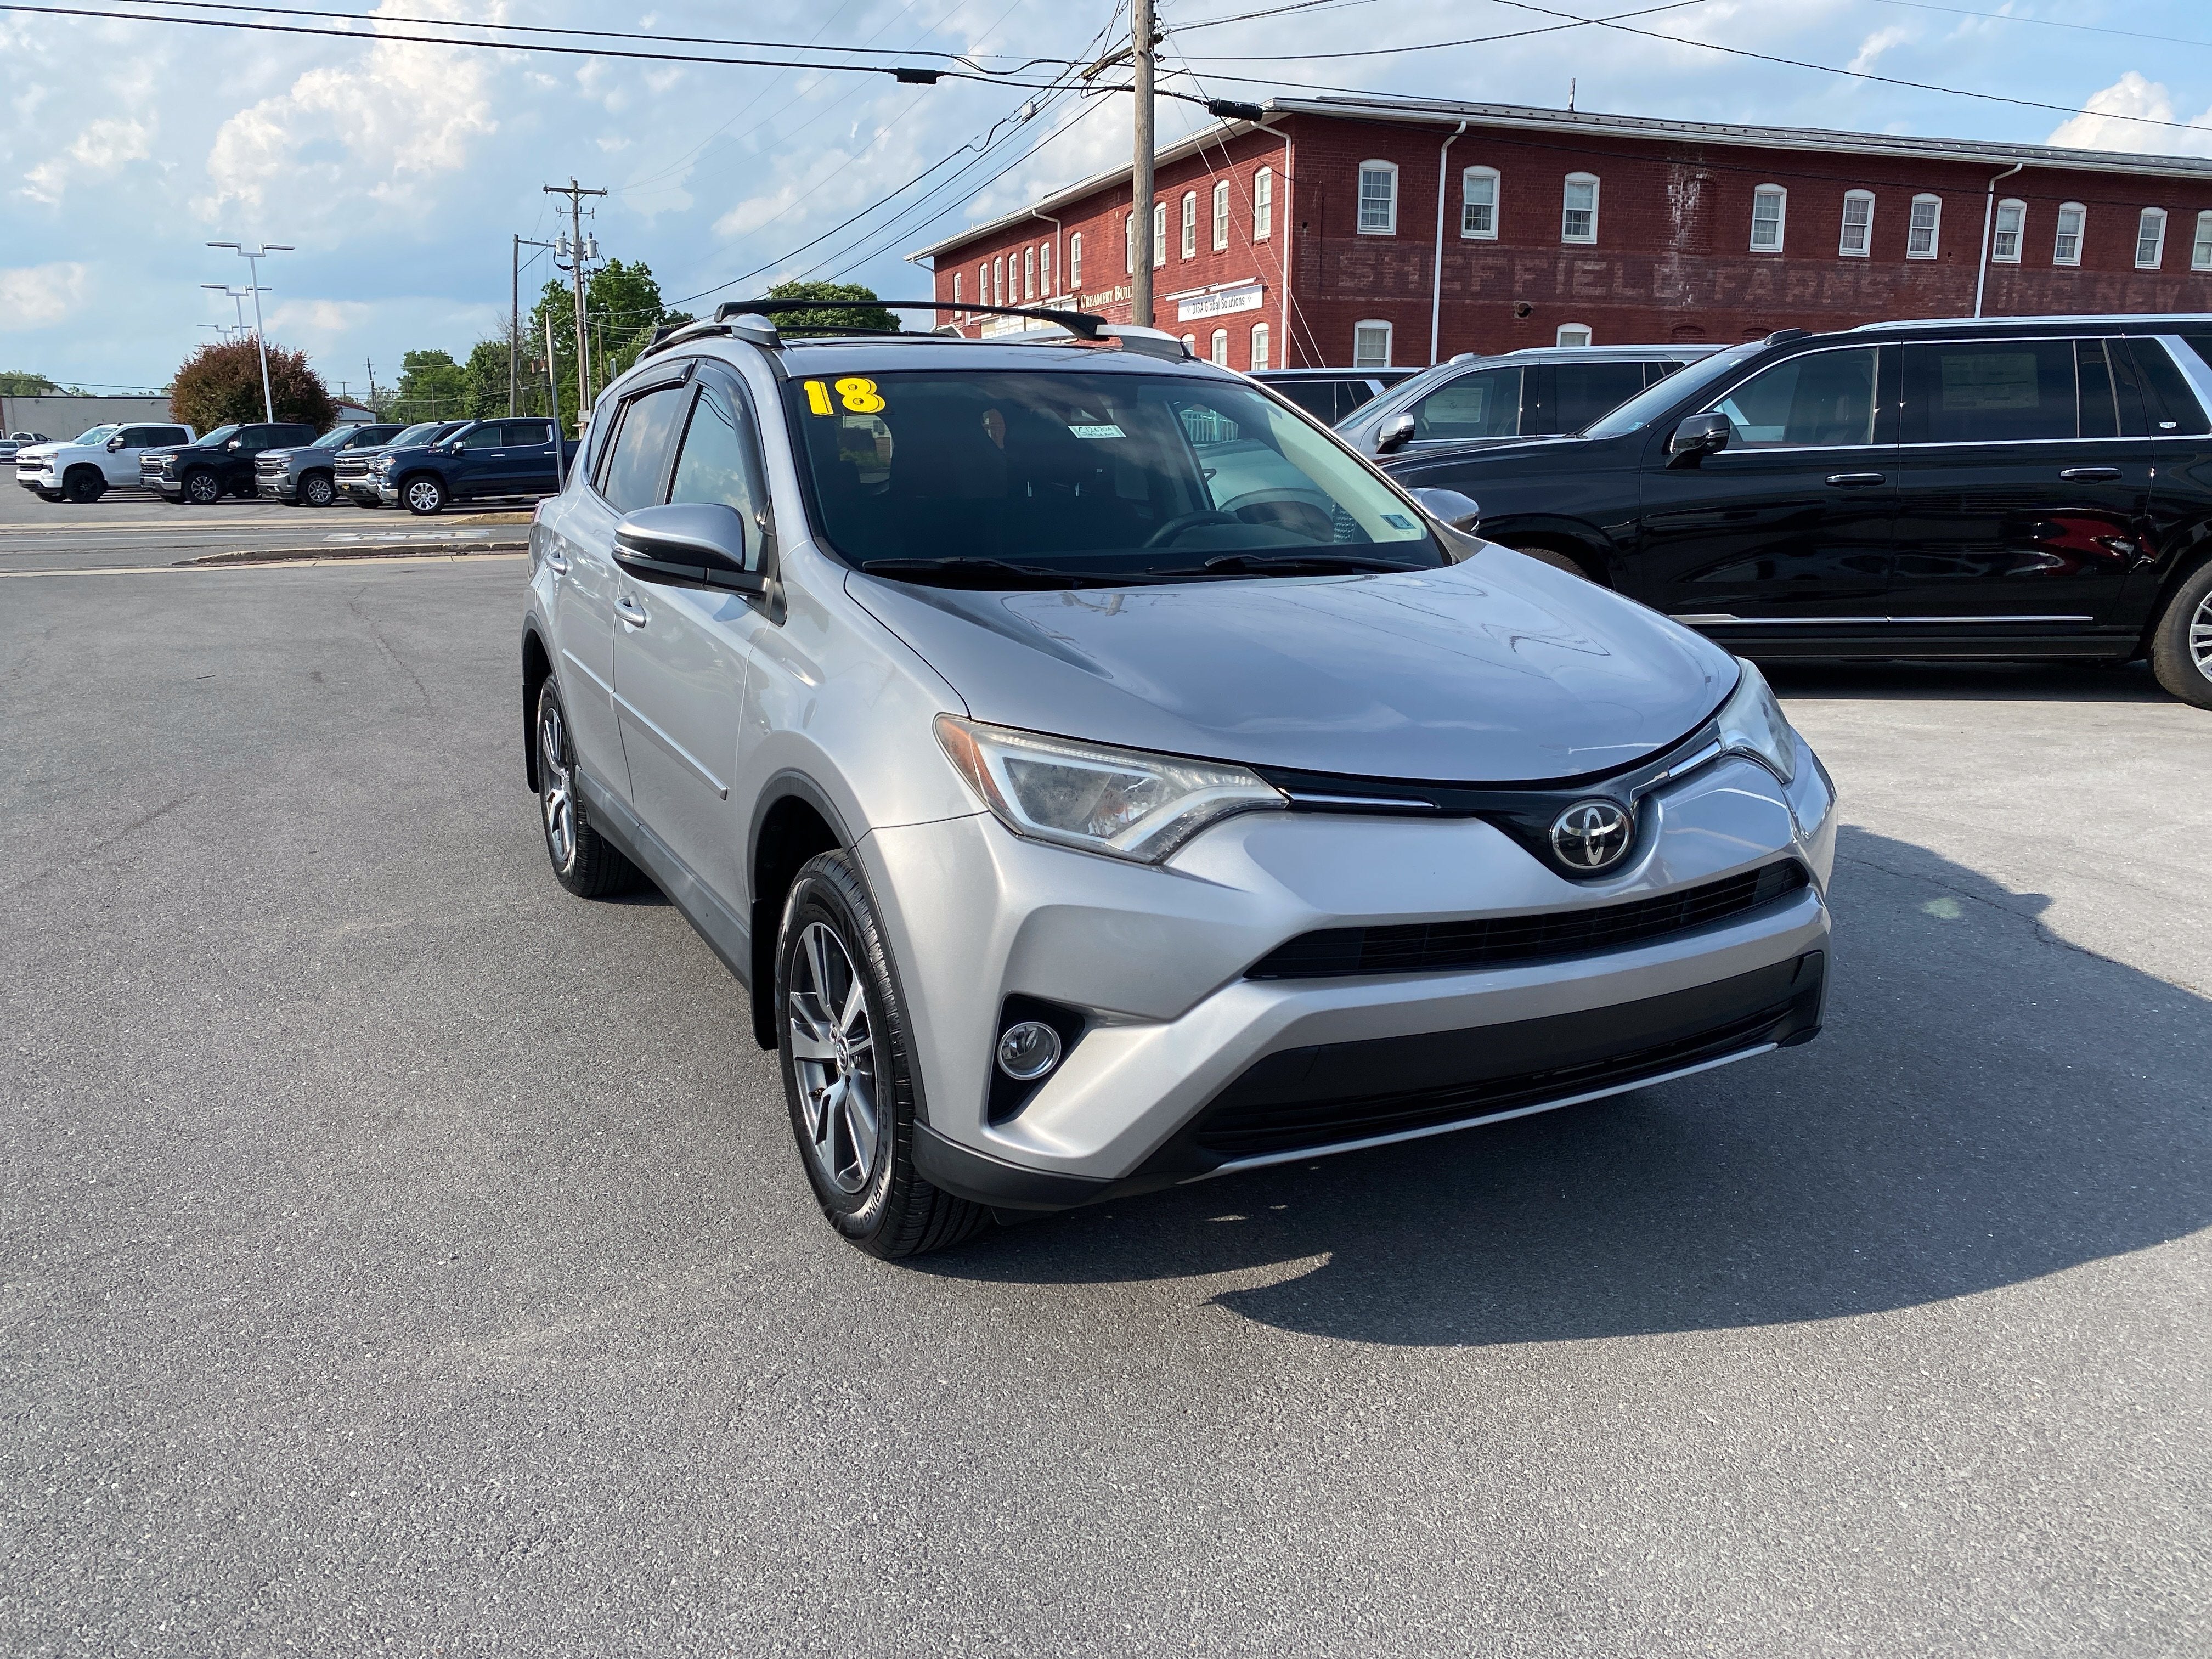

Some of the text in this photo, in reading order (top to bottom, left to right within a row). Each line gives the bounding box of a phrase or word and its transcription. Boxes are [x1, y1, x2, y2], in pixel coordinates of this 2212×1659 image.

[1080, 290, 1114, 309] CREAMERY
[1192, 295, 1245, 314] DISA Global Solutions
[804, 377, 885, 415] 18
[863, 1140, 888, 1226] TOURING
